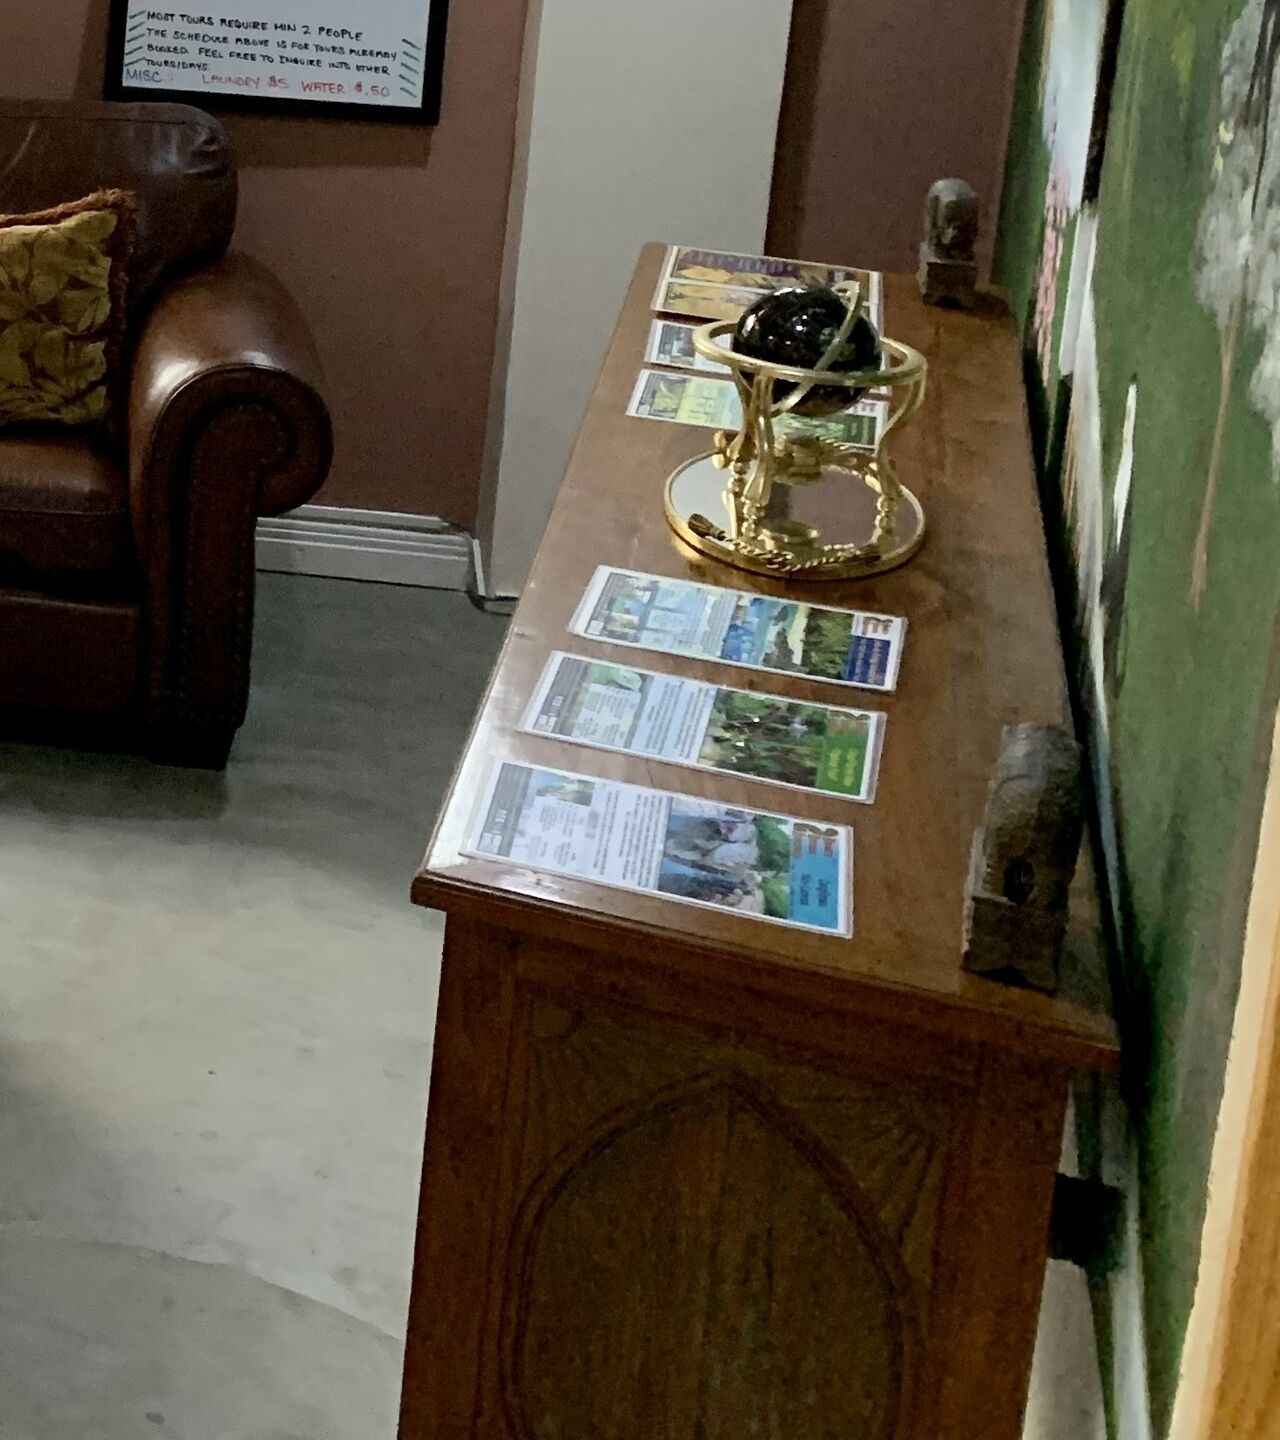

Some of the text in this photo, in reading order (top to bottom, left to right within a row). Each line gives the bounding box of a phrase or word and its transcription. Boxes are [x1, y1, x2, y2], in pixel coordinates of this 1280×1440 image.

[147, 10, 363, 41] MOST TOURS REQUIRE MIN 2 PEOPLE
[146, 27, 397, 61] THE SCHEDULE ABOVE IS FOR TOURS ALREADY
[198, 47, 224, 59] FEEL
[228, 51, 257, 62] FREE
[259, 54, 274, 64] TO
[278, 55, 322, 67] INQUIRE
[328, 61, 351, 71] INTO
[355, 64, 390, 76] OTHER
[202, 74, 260, 89] LAUNDRY
[301, 80, 345, 94] WATER
